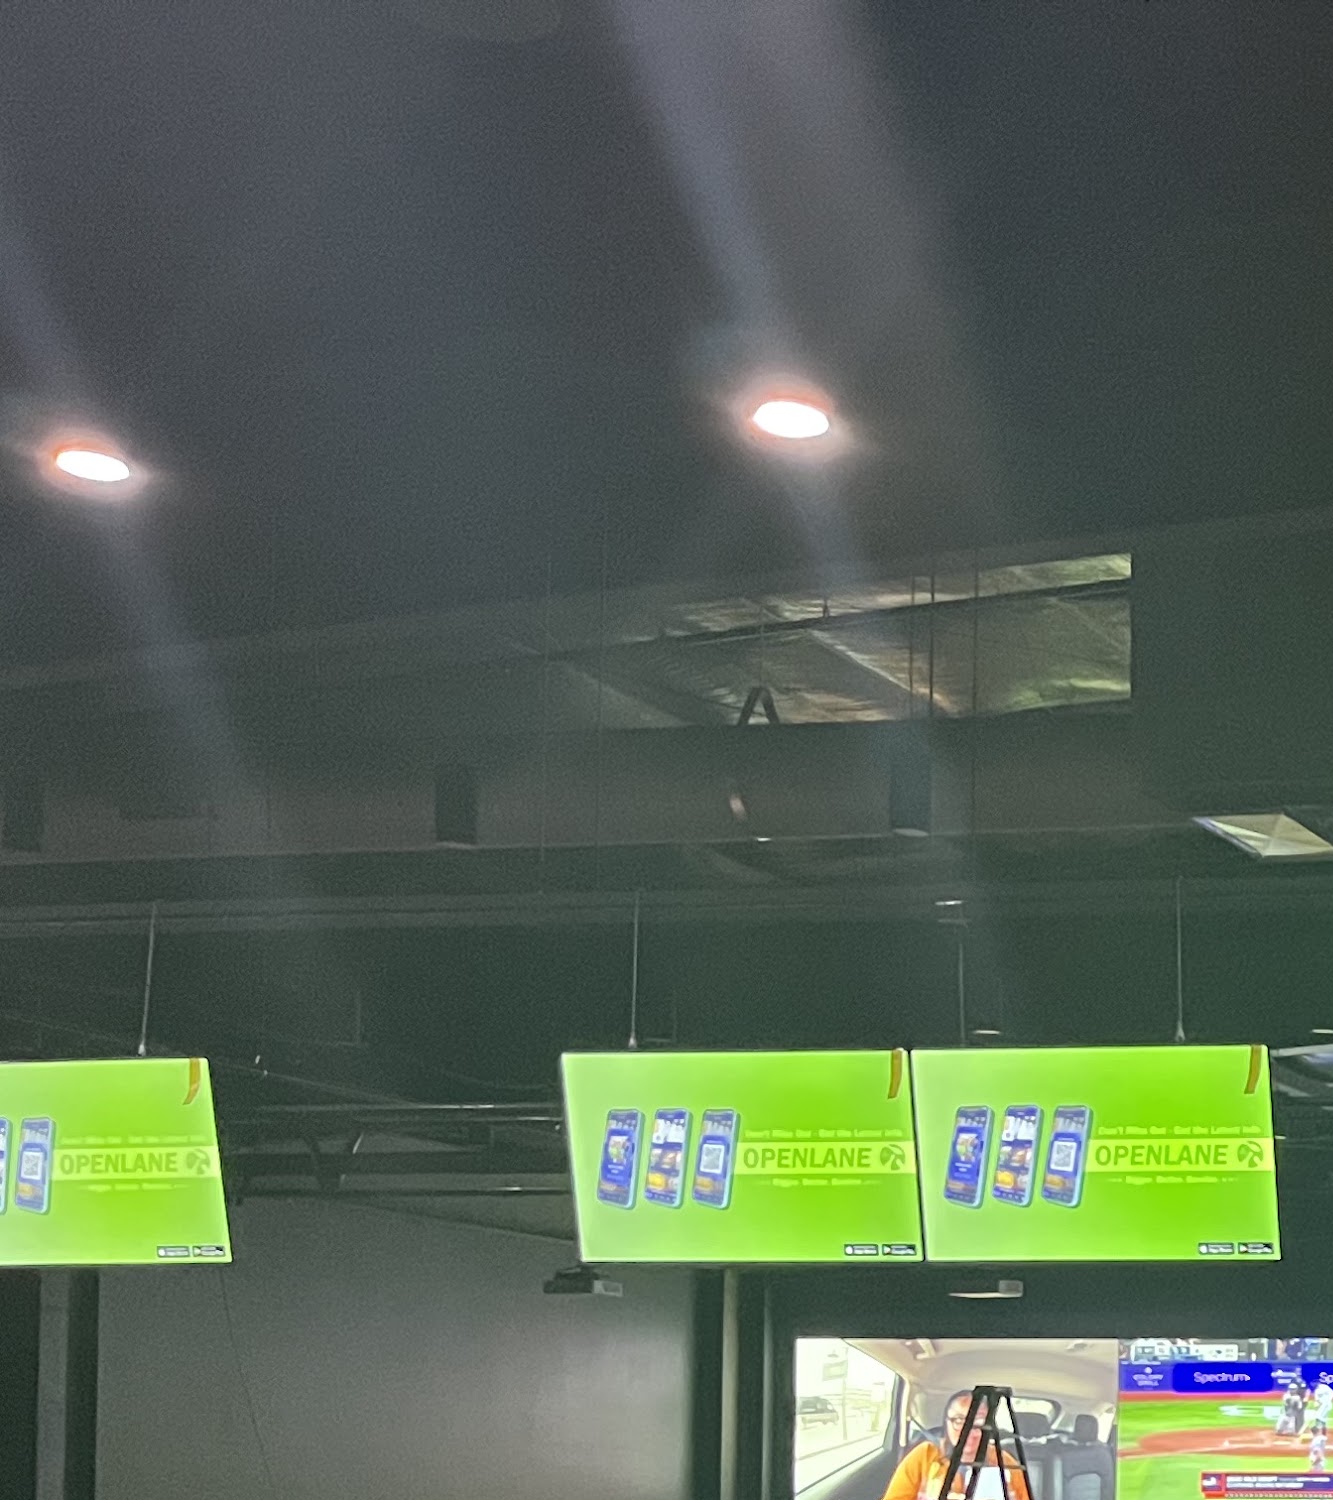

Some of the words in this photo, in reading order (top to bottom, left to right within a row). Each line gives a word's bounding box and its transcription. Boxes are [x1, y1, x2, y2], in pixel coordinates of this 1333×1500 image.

[60, 1153, 178, 1175] OPENLANE
[743, 1147, 872, 1168] OPENLANE
[1095, 1144, 1228, 1166] OPENLANE
[1194, 1372, 1249, 1384] Spectrum
